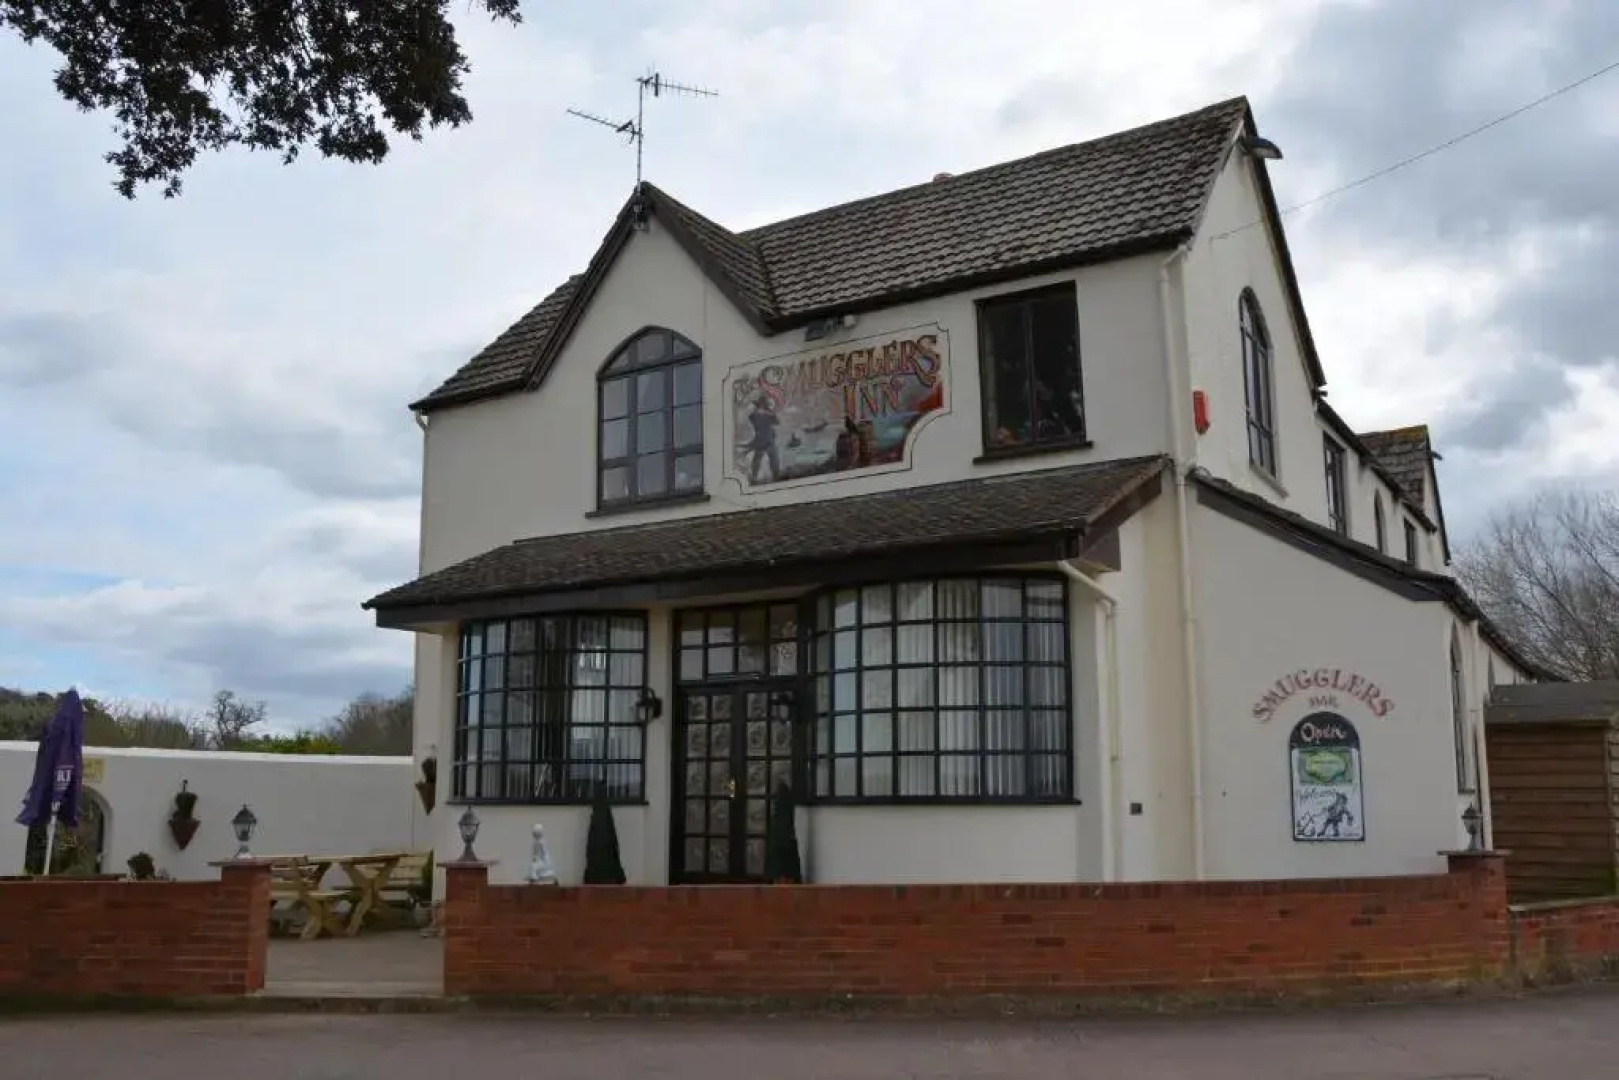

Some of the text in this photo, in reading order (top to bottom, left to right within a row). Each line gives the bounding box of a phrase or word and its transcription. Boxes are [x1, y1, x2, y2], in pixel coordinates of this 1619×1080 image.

[759, 335, 941, 408] SMUGGLERS
[843, 377, 900, 420] INN
[1253, 669, 1395, 722] SMUGGLERS
[1301, 722, 1348, 744] Open
